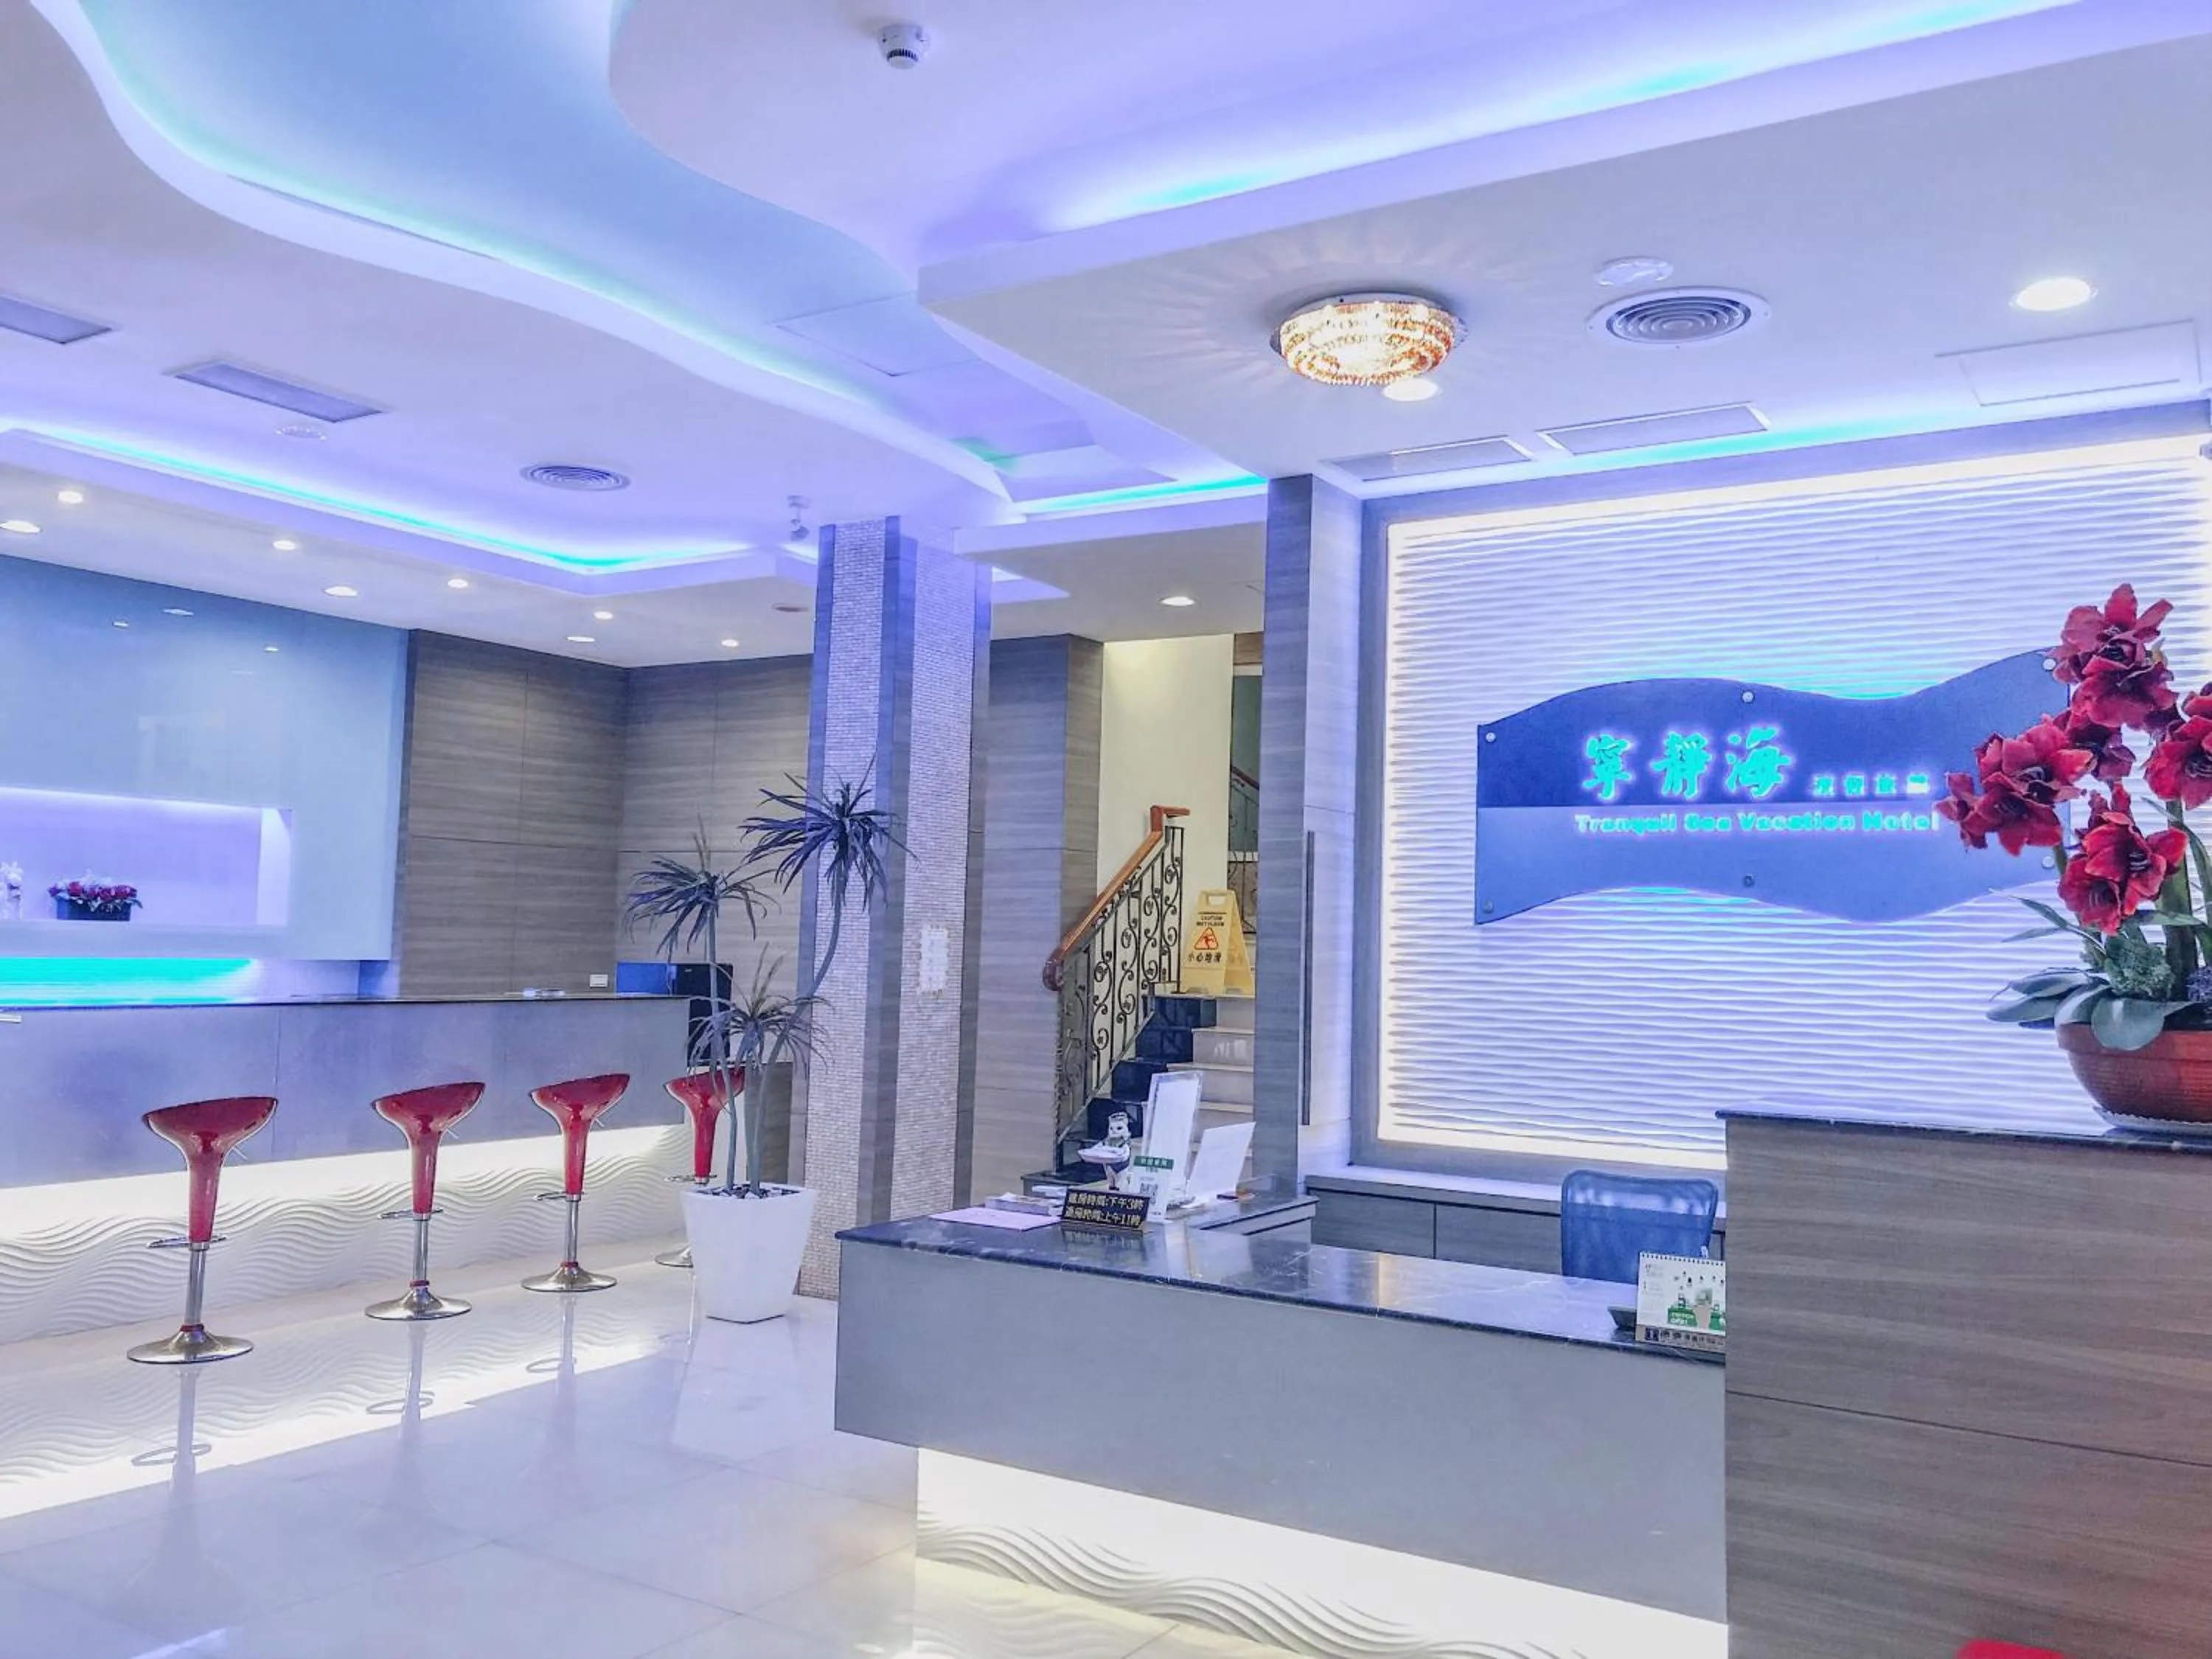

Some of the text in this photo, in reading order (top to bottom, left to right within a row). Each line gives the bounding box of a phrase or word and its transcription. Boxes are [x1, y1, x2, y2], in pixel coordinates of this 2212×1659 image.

[1583, 726, 1792, 800] 寧靜海
[1684, 813, 1732, 832] Sea
[1737, 812, 1856, 831] Vacation
